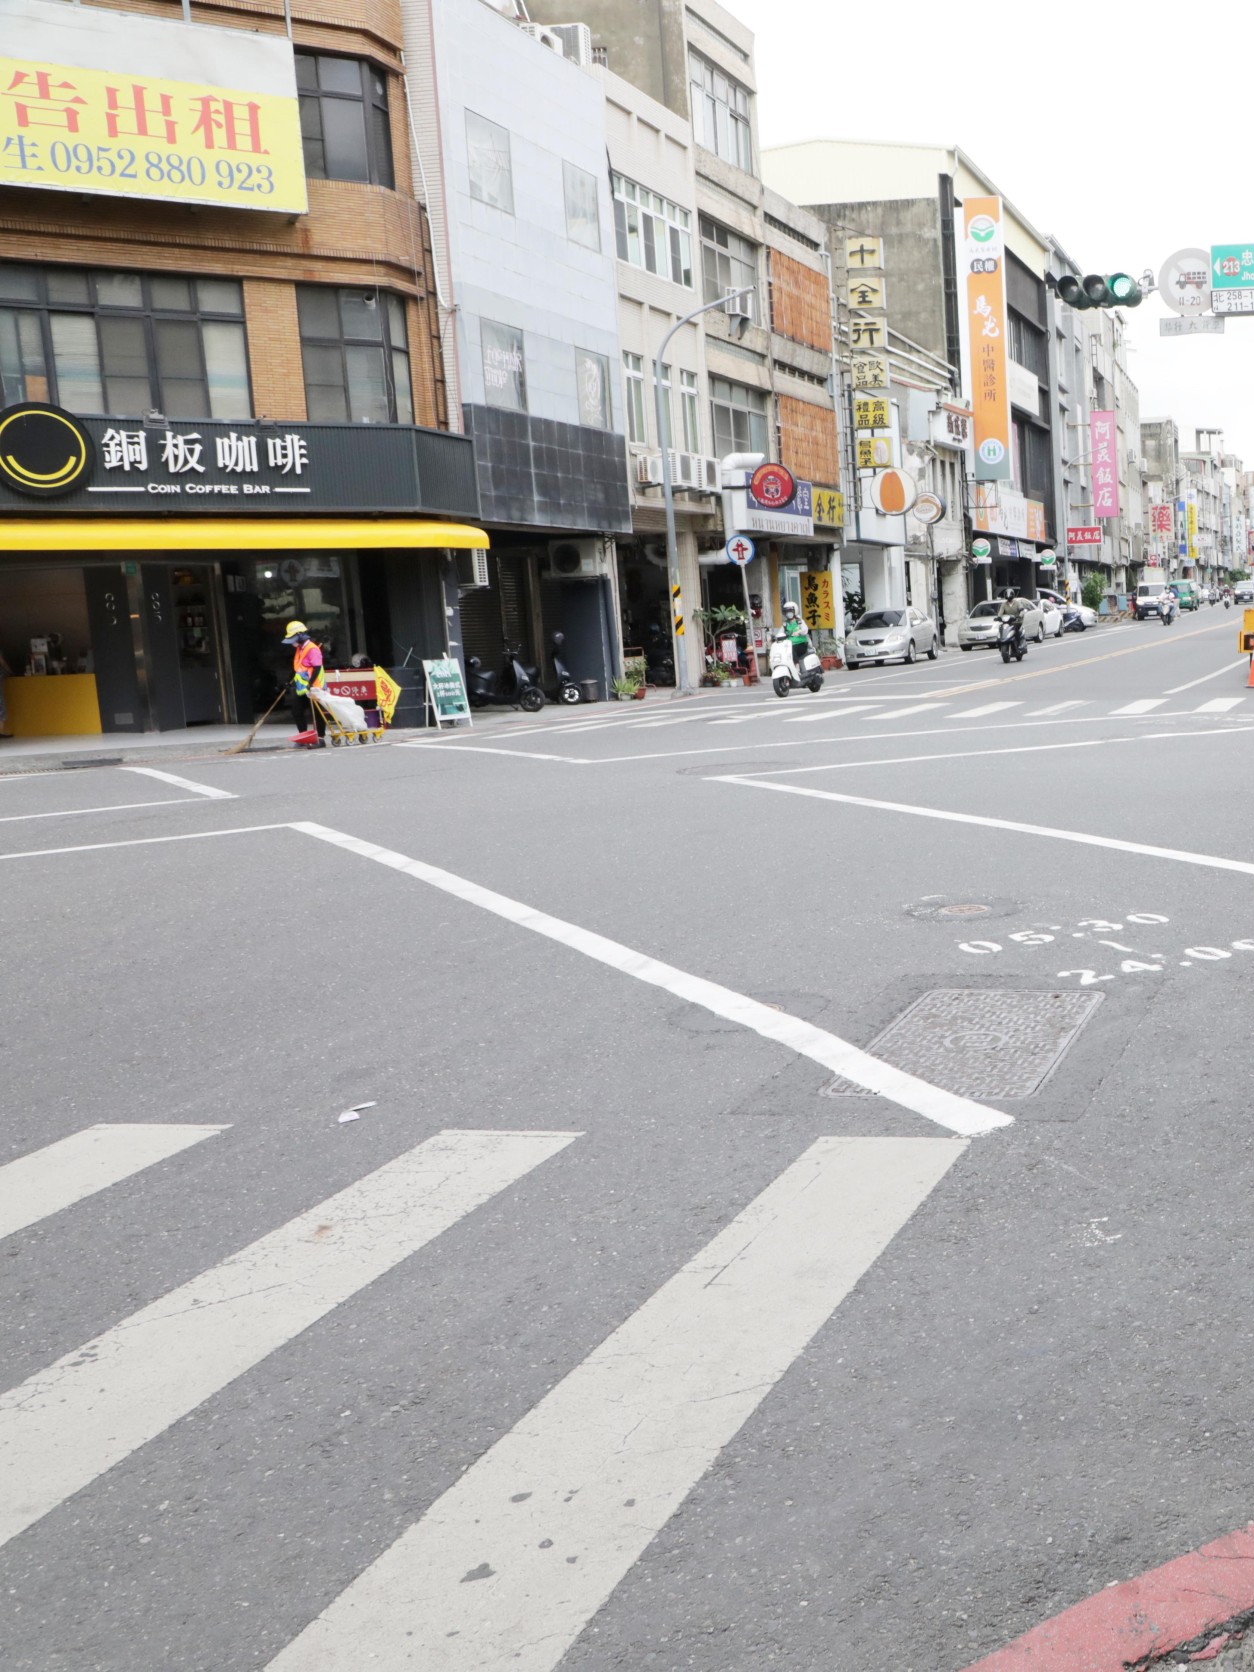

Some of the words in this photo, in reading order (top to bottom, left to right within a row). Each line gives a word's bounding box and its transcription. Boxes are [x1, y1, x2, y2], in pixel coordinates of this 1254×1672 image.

[145, 151, 206, 187] 880
[217, 160, 275, 195] 923
[1223, 261, 1240, 274] 213
[982, 343, 997, 402] 中醫診所
[101, 428, 309, 474] 銅板咖啡
[1151, 505, 1172, 533] 藥
[821, 578, 831, 622] カラスミ
